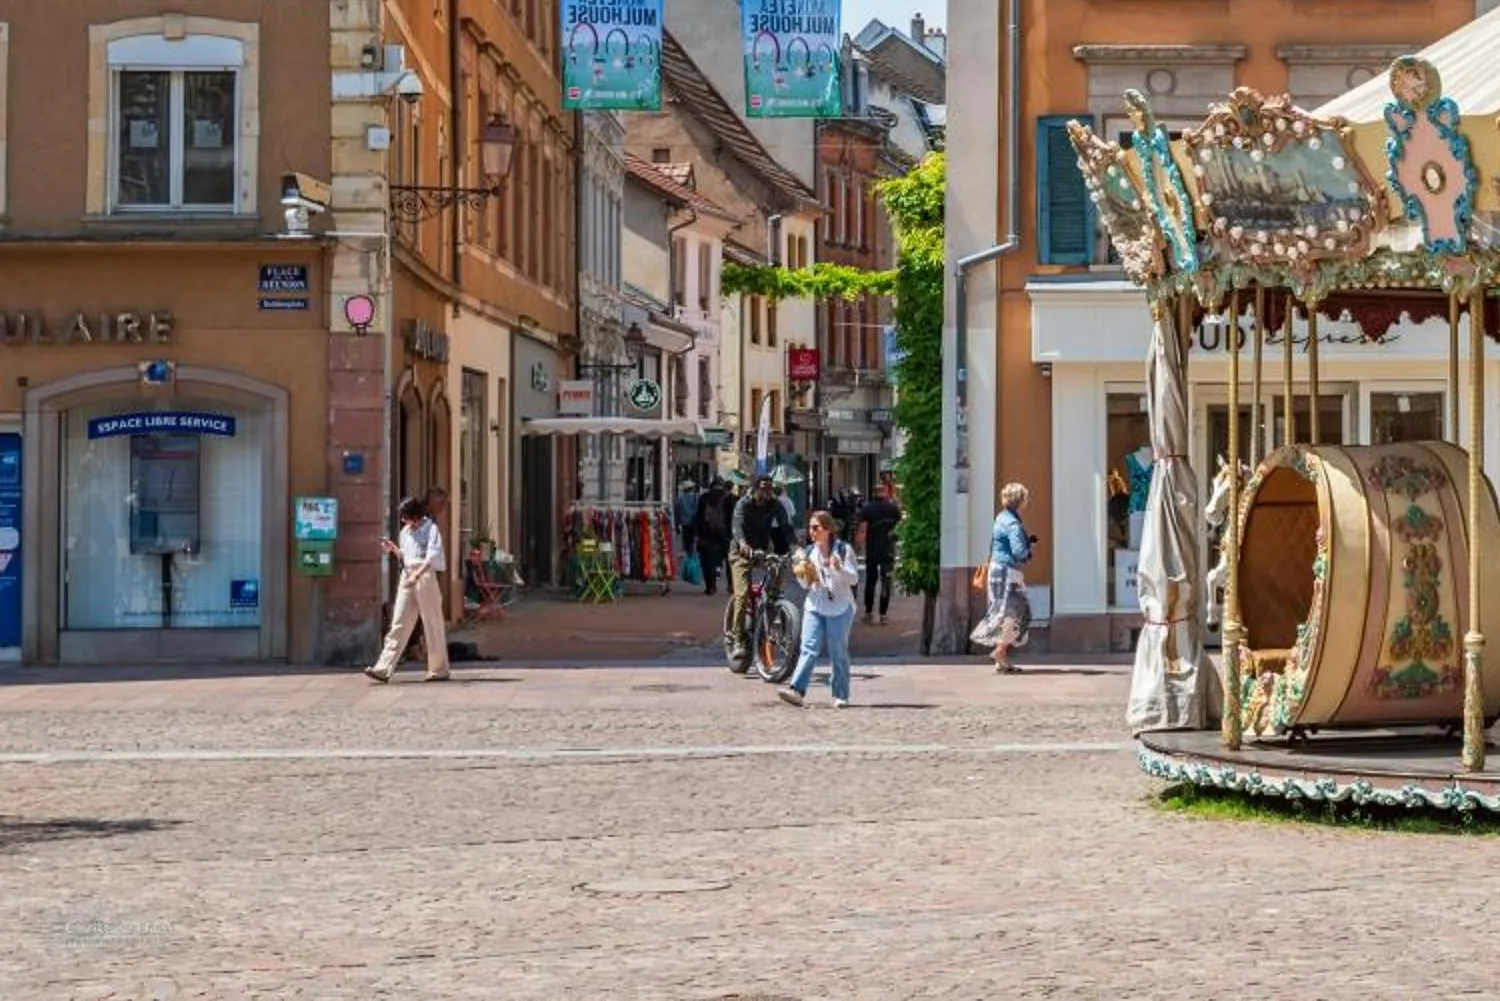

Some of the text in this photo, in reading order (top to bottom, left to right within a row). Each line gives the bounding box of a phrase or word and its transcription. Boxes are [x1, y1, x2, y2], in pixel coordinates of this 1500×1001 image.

[97, 416, 227, 434] ESPACE LIBRE SERVICE
